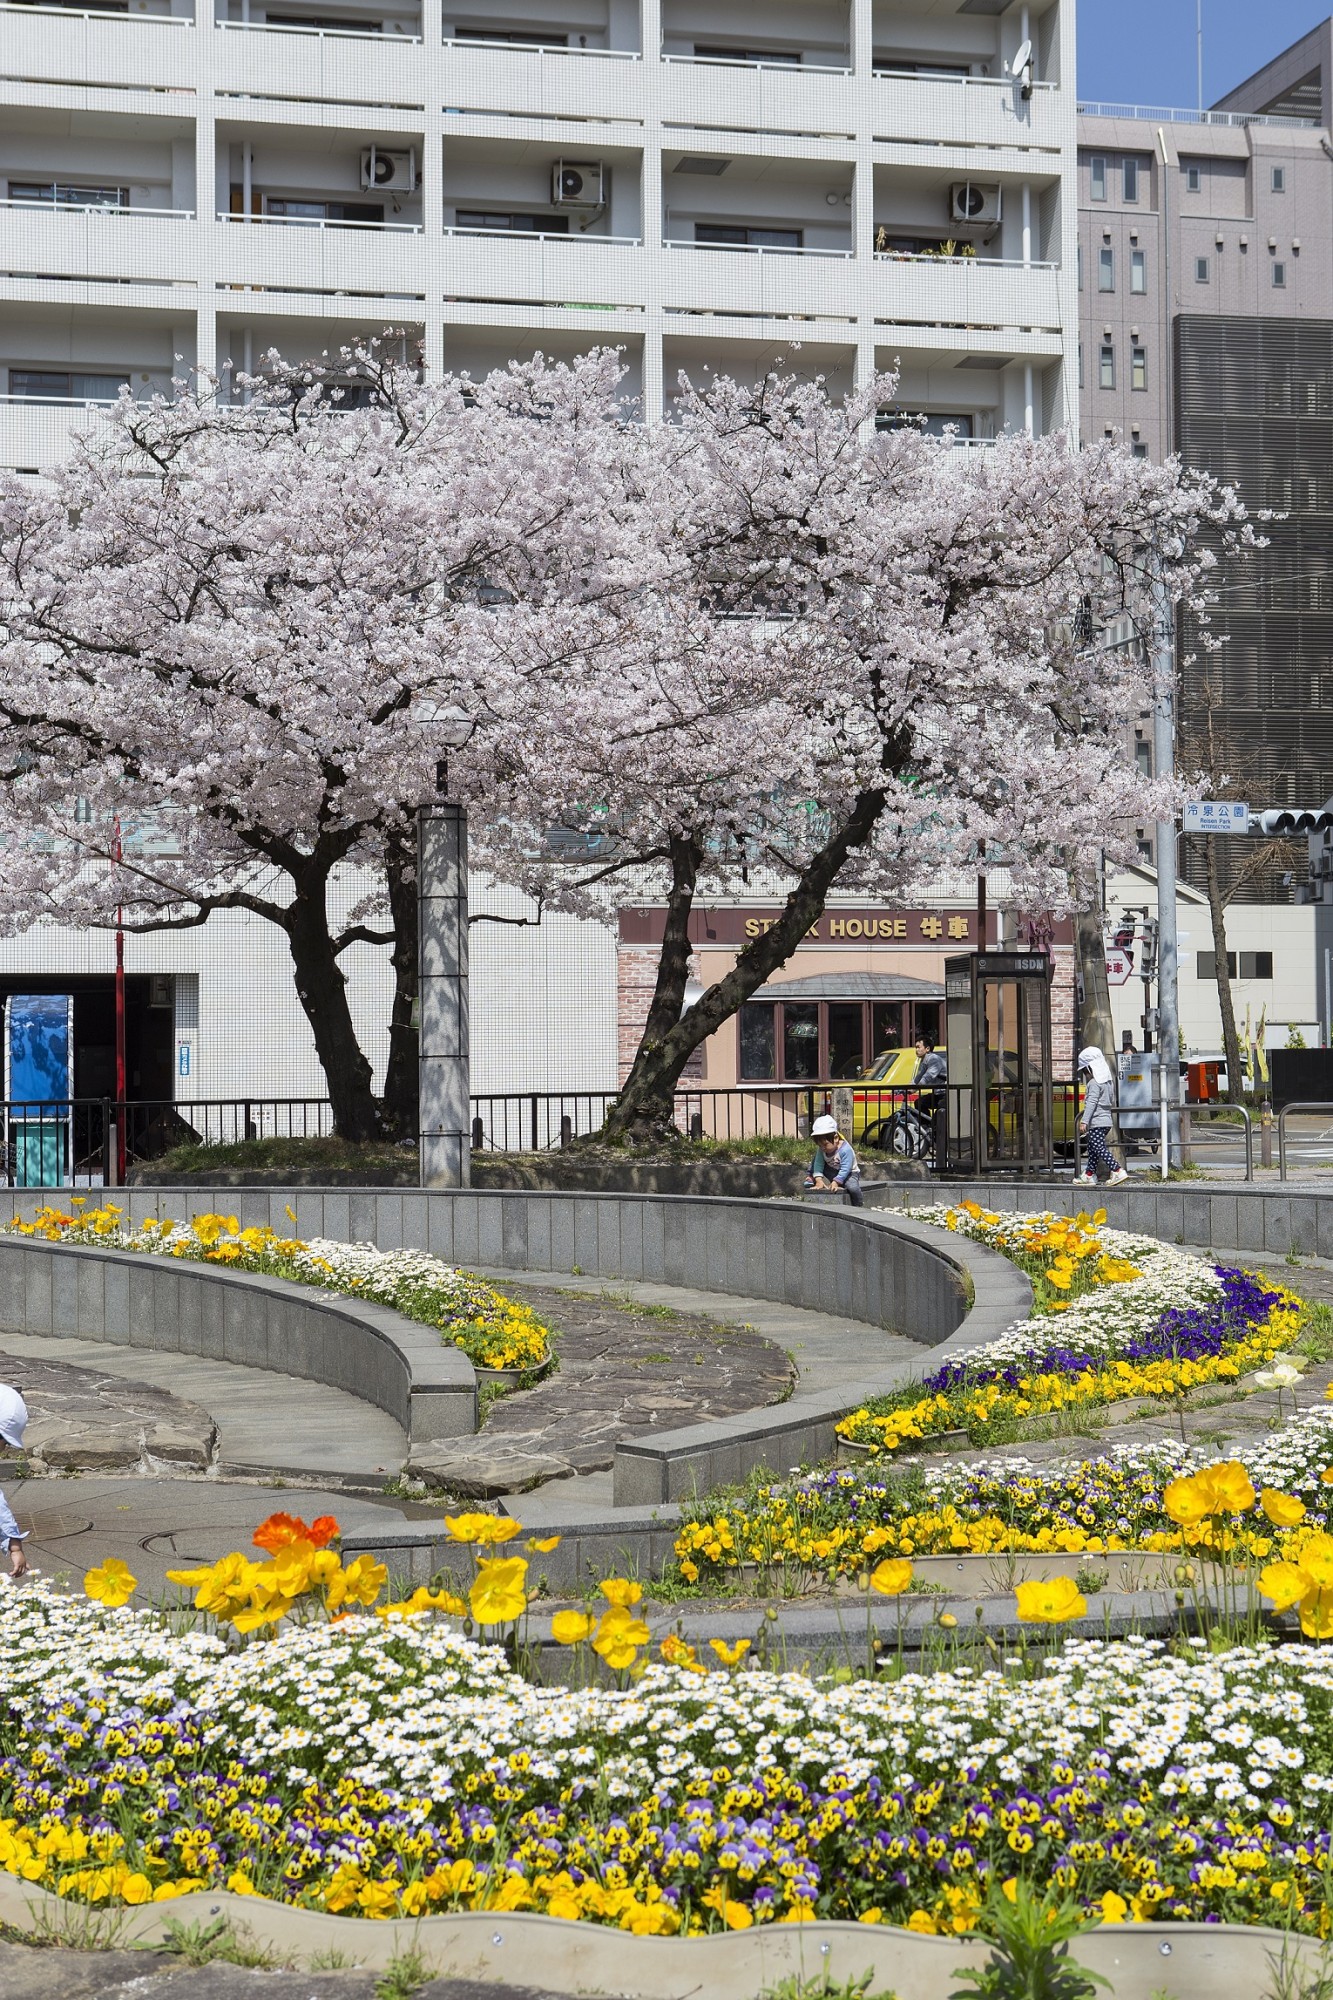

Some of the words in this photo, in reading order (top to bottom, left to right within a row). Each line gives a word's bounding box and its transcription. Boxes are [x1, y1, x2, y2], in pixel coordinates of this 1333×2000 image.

[1187, 804, 1244, 818] 冷泉公園
[745, 918, 819, 938] STK
[830, 918, 907, 938] HOUSE
[920, 915, 969, 939] 牛車
